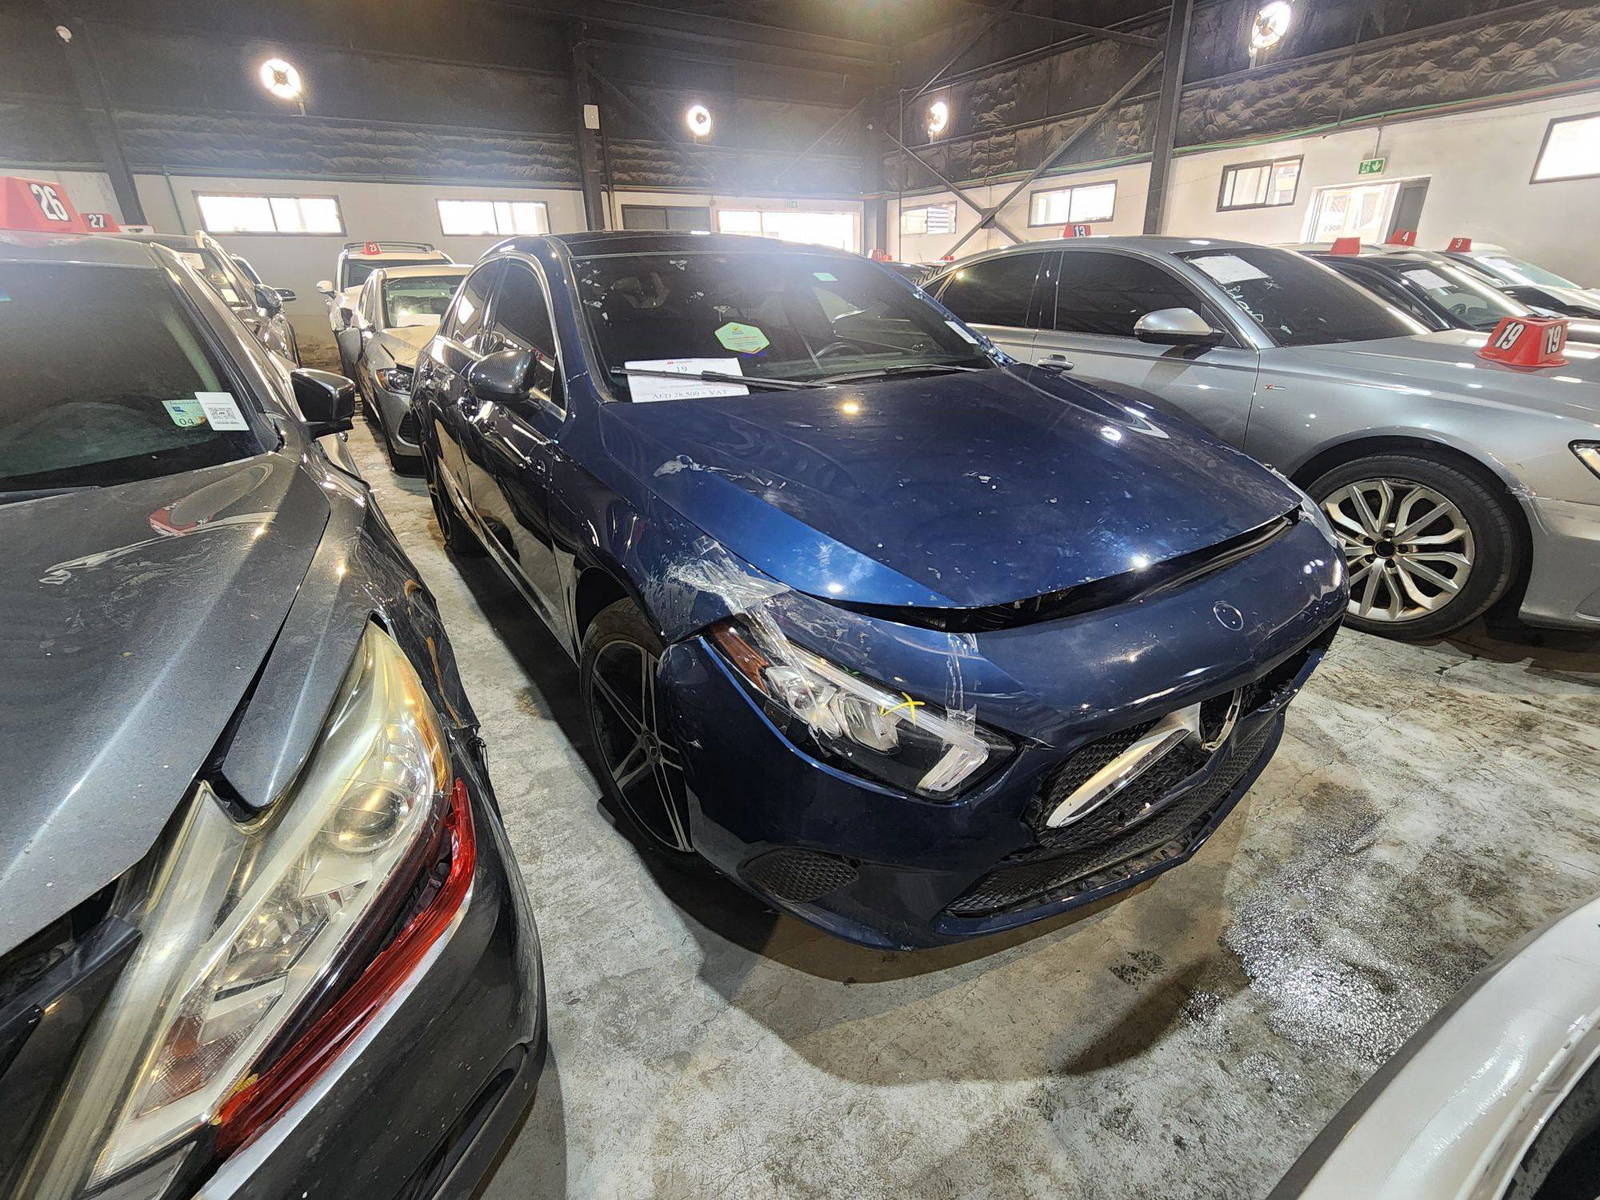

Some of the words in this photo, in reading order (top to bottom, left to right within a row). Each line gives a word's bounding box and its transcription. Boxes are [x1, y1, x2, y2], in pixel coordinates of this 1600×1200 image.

[30, 183, 69, 221] 26
[88, 214, 105, 228] 27
[1074, 225, 1086, 239] 13
[1401, 232, 1409, 242] 4
[1455, 240, 1463, 249] 3
[1495, 322, 1524, 349] 19
[1547, 325, 1561, 353] 19
